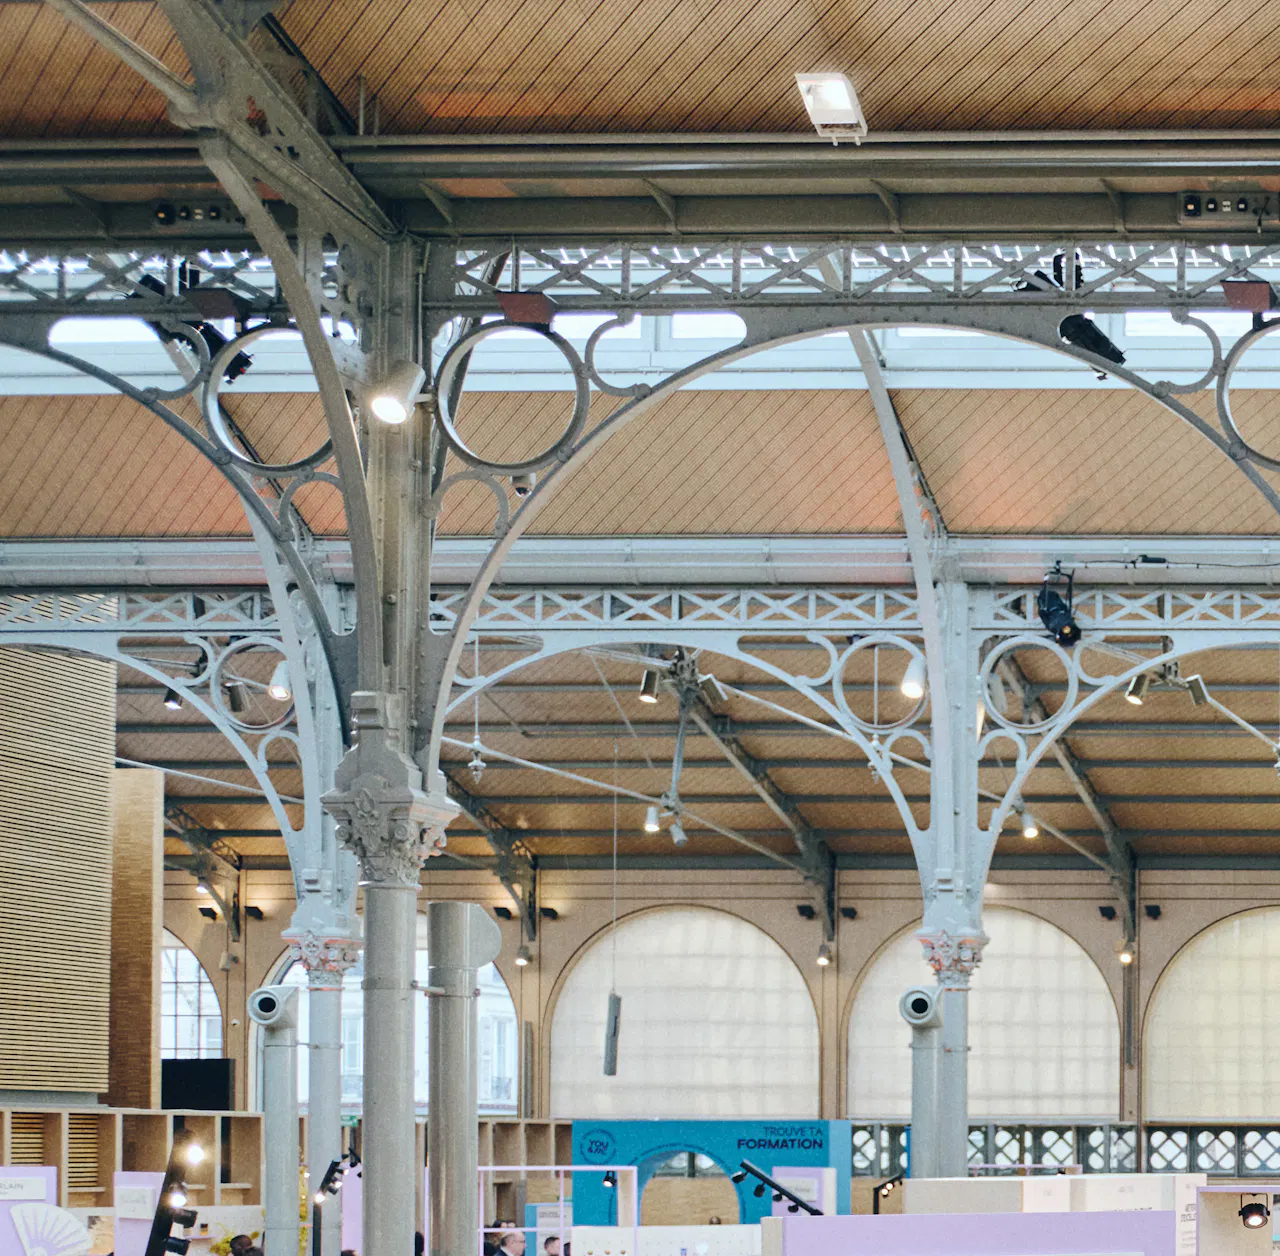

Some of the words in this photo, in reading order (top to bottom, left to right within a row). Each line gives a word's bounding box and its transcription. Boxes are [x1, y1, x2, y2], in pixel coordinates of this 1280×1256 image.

[764, 1127, 808, 1136] TROUVE
[810, 1127, 823, 1136] TA
[737, 1139, 823, 1150] FORMATION
